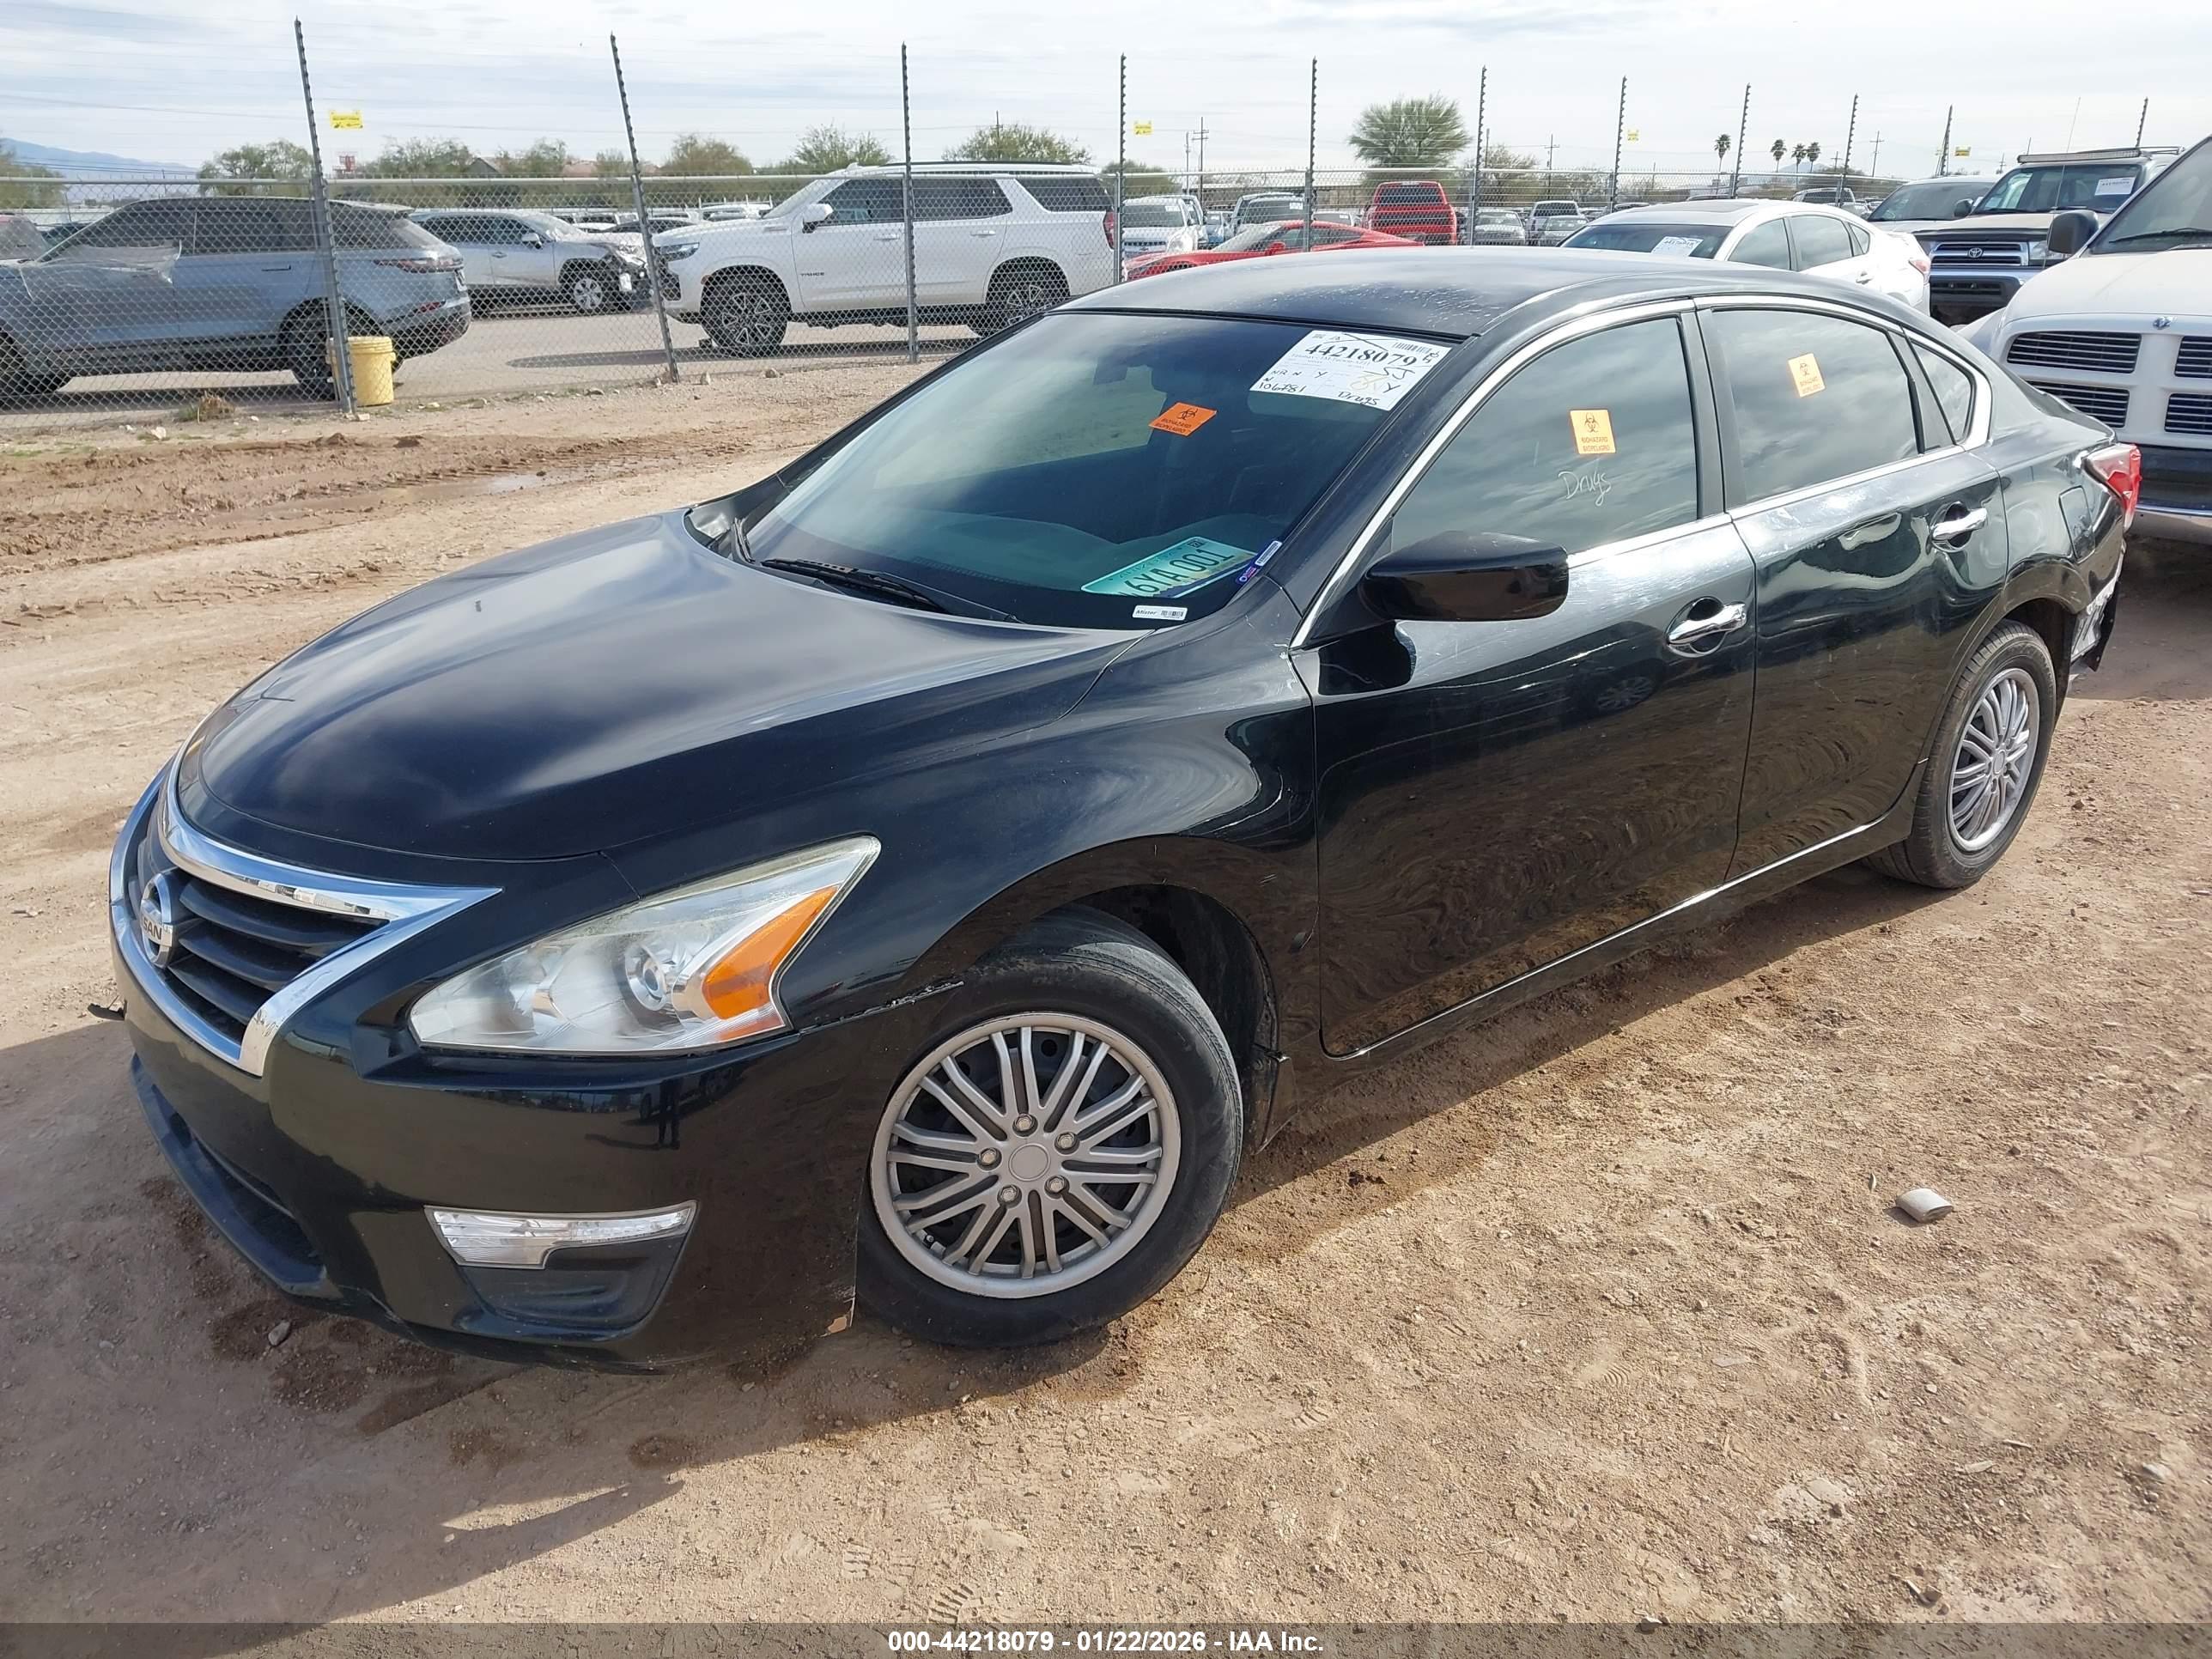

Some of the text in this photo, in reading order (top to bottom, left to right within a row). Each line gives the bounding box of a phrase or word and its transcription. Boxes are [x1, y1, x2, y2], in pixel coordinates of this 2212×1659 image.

[1304, 343, 1417, 366] 44218079
[1338, 391, 1381, 405] Drugs
[1558, 470, 1612, 507] Drugs
